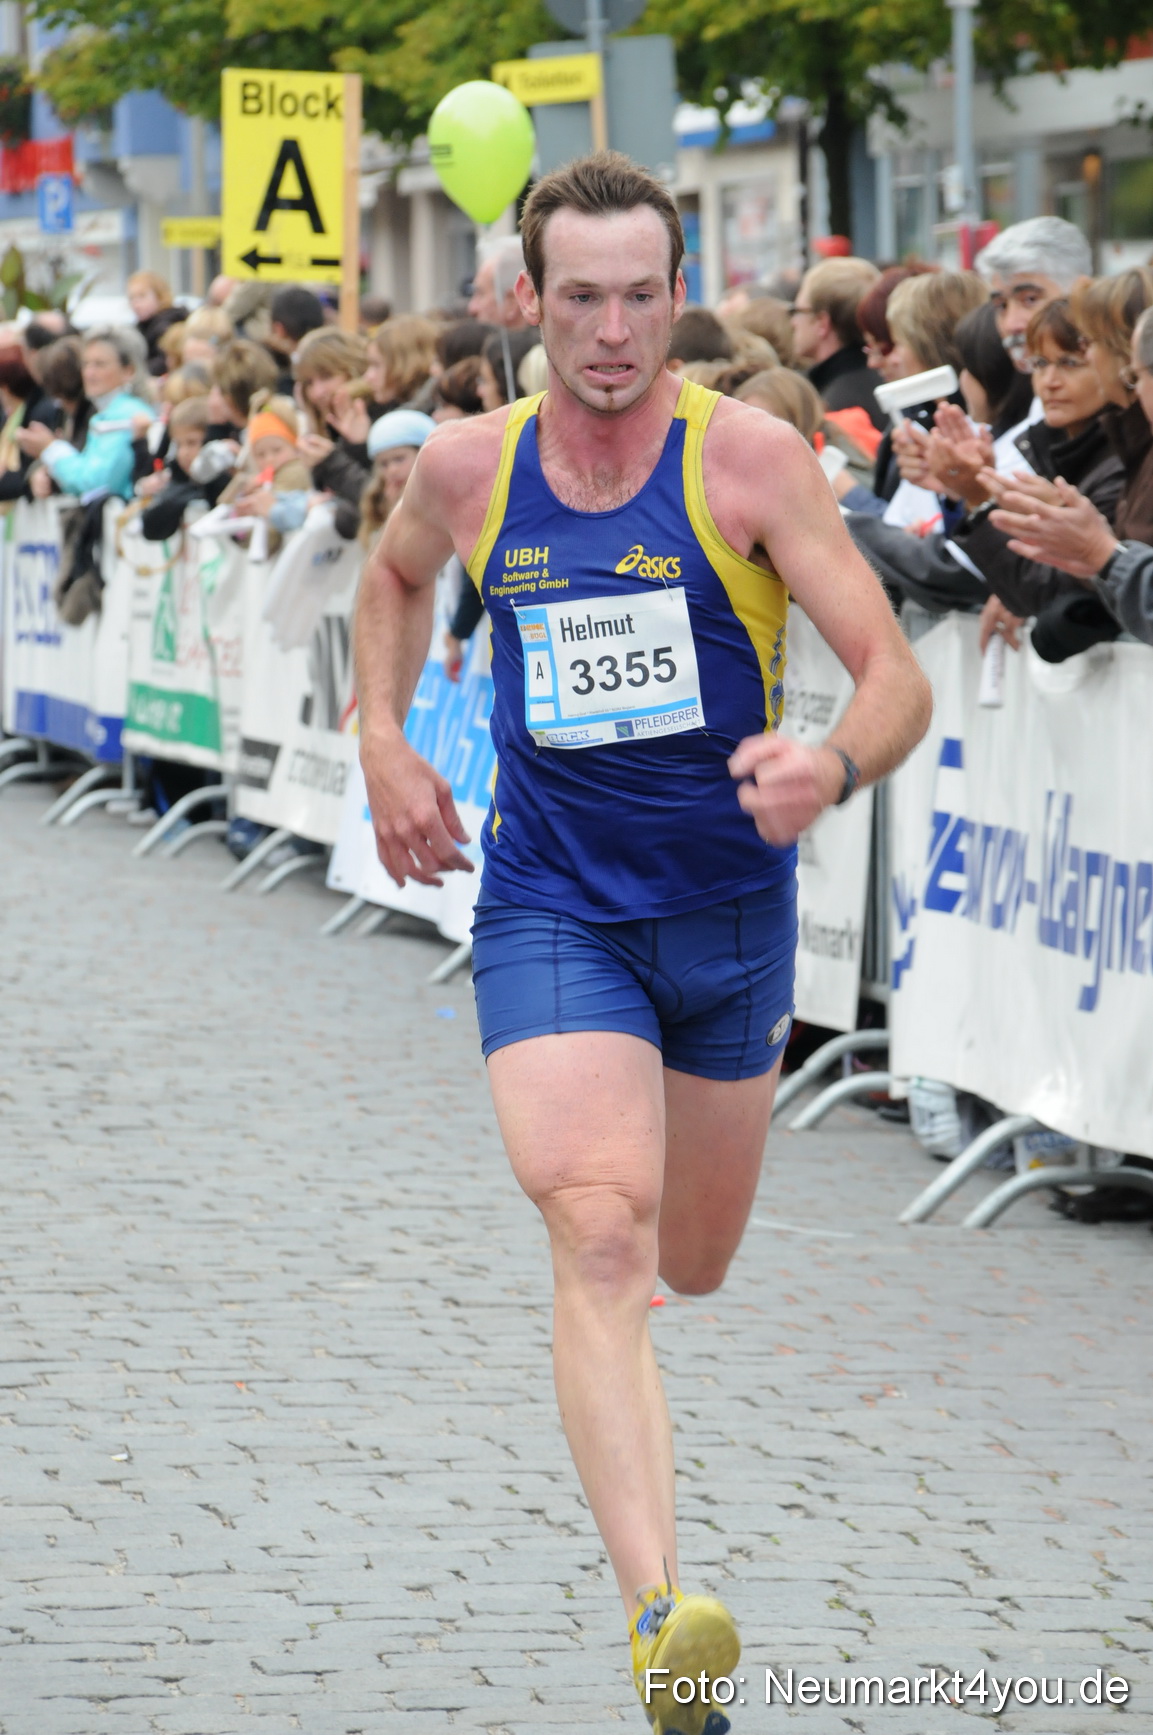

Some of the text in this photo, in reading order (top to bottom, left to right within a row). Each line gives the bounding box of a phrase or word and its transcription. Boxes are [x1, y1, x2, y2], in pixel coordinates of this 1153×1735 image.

[241, 82, 343, 118] Block
[254, 136, 327, 235] A
[505, 546, 549, 568] UBH
[637, 556, 681, 579] asics
[489, 578, 569, 597] Engineering GmbH
[502, 568, 550, 584] Software &
[560, 614, 635, 643] Helmut
[536, 661, 545, 680] A
[569, 646, 677, 696] 3355
[634, 707, 700, 730] PFLEIDERER
[546, 730, 590, 743] BOCK
